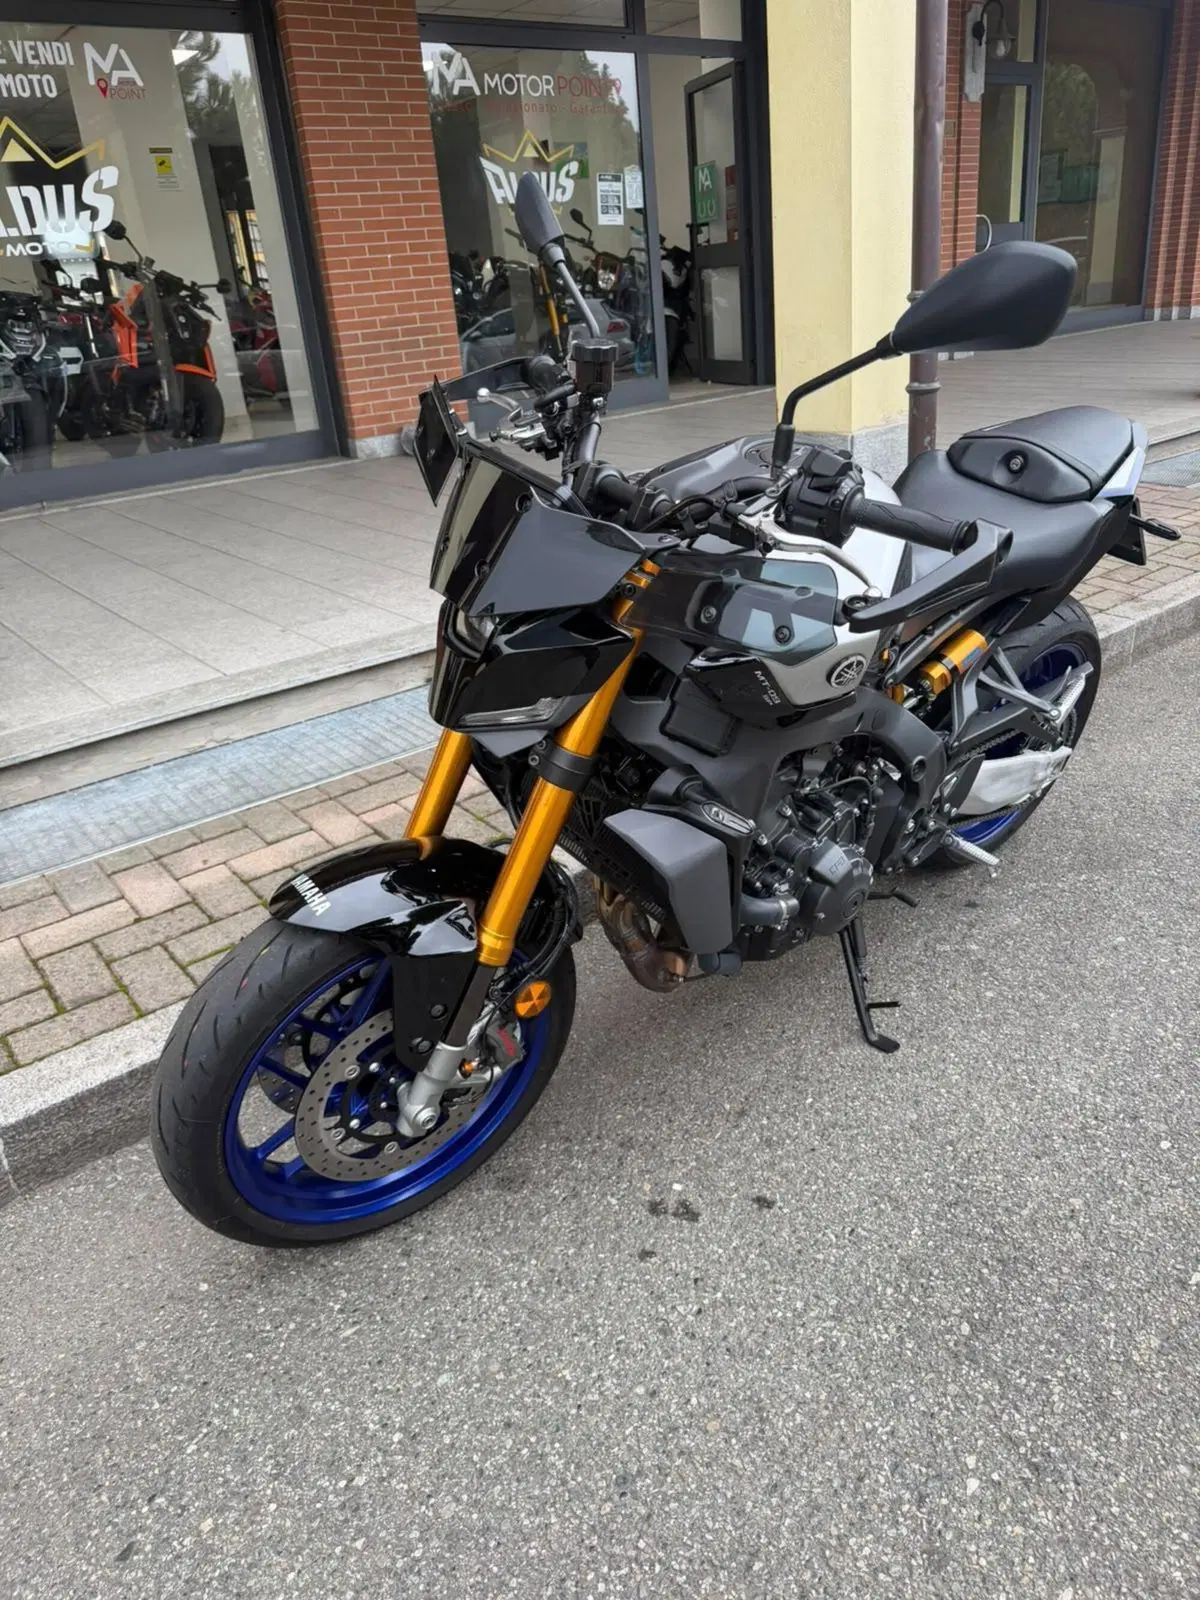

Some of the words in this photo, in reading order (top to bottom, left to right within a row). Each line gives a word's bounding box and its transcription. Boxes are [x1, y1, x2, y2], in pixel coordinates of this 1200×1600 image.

[8, 40, 75, 66] VENDI
[0, 73, 58, 98] MOTO
[111, 88, 146, 100] POINT
[6, 241, 71, 257] MOTO
[754, 670, 782, 705] MT-09
[290, 873, 331, 916] YAMAHA
